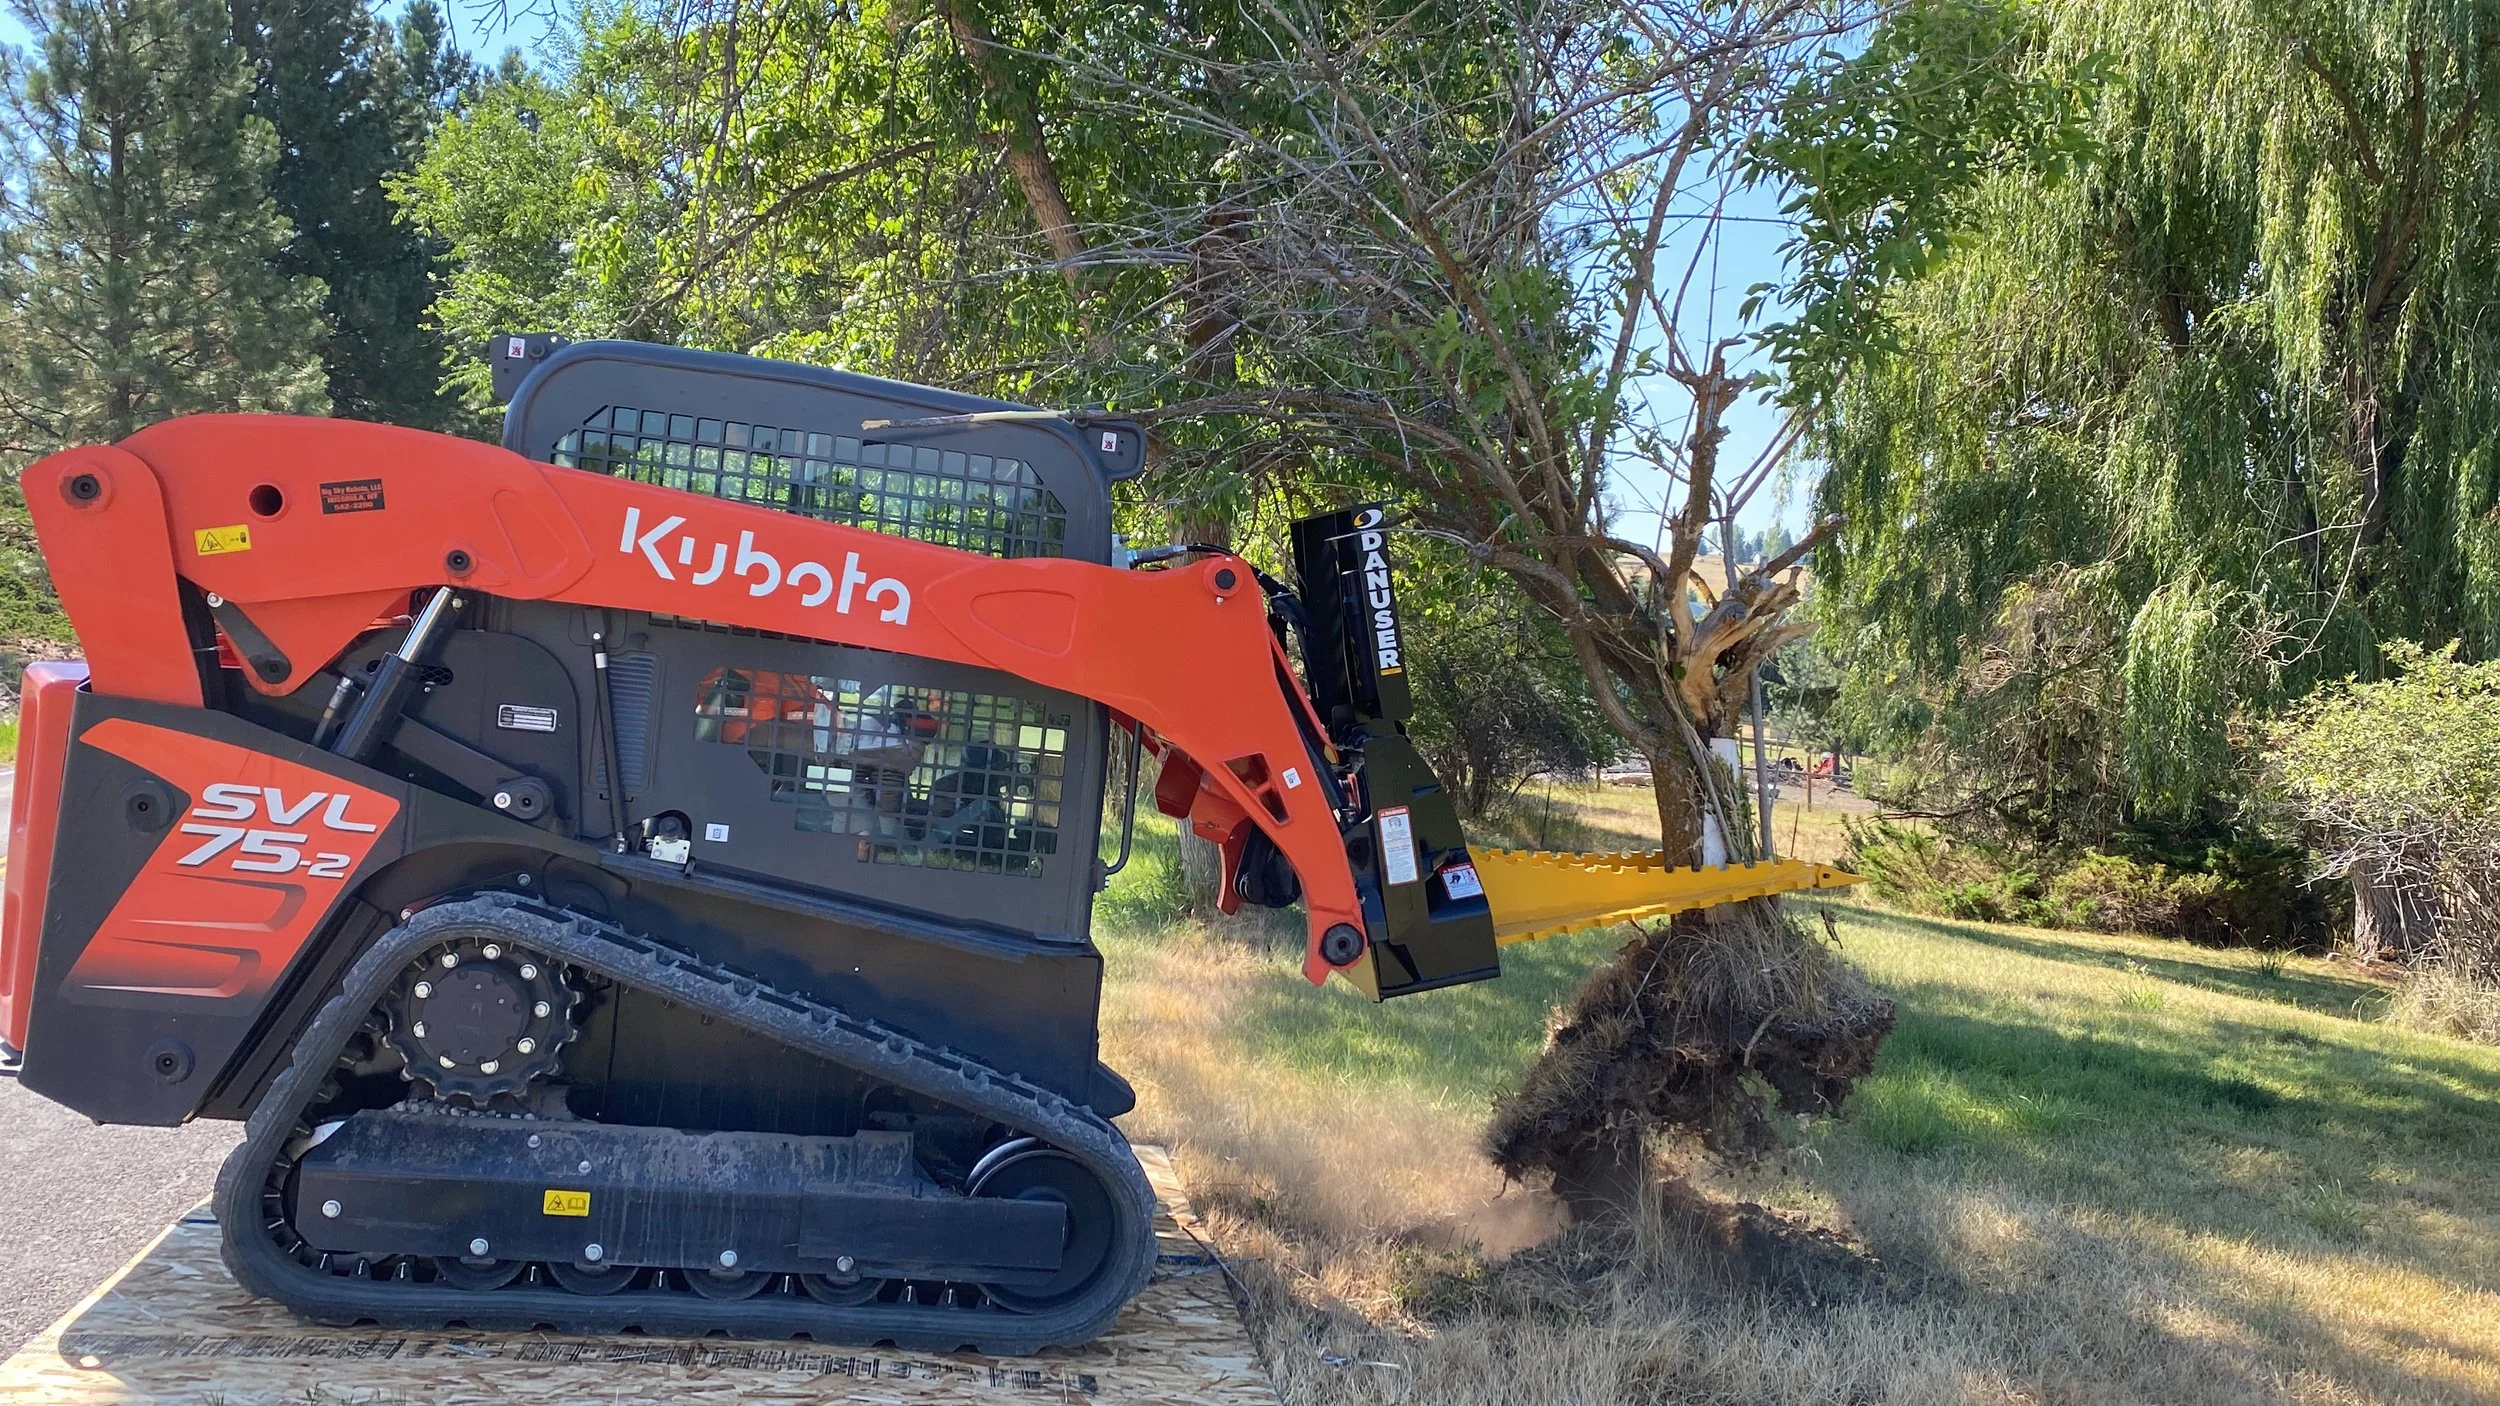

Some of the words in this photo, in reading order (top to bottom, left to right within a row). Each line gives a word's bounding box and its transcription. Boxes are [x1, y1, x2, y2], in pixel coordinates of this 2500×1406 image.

[321, 488, 332, 496] Big
[333, 486, 345, 494] Sky
[370, 483, 382, 491] LLC
[366, 492, 378, 500] MT
[619, 506, 911, 625] Kubota
[1361, 532, 1401, 669] DANUSER
[192, 783, 377, 832] SVL
[175, 823, 351, 878] 75-2
